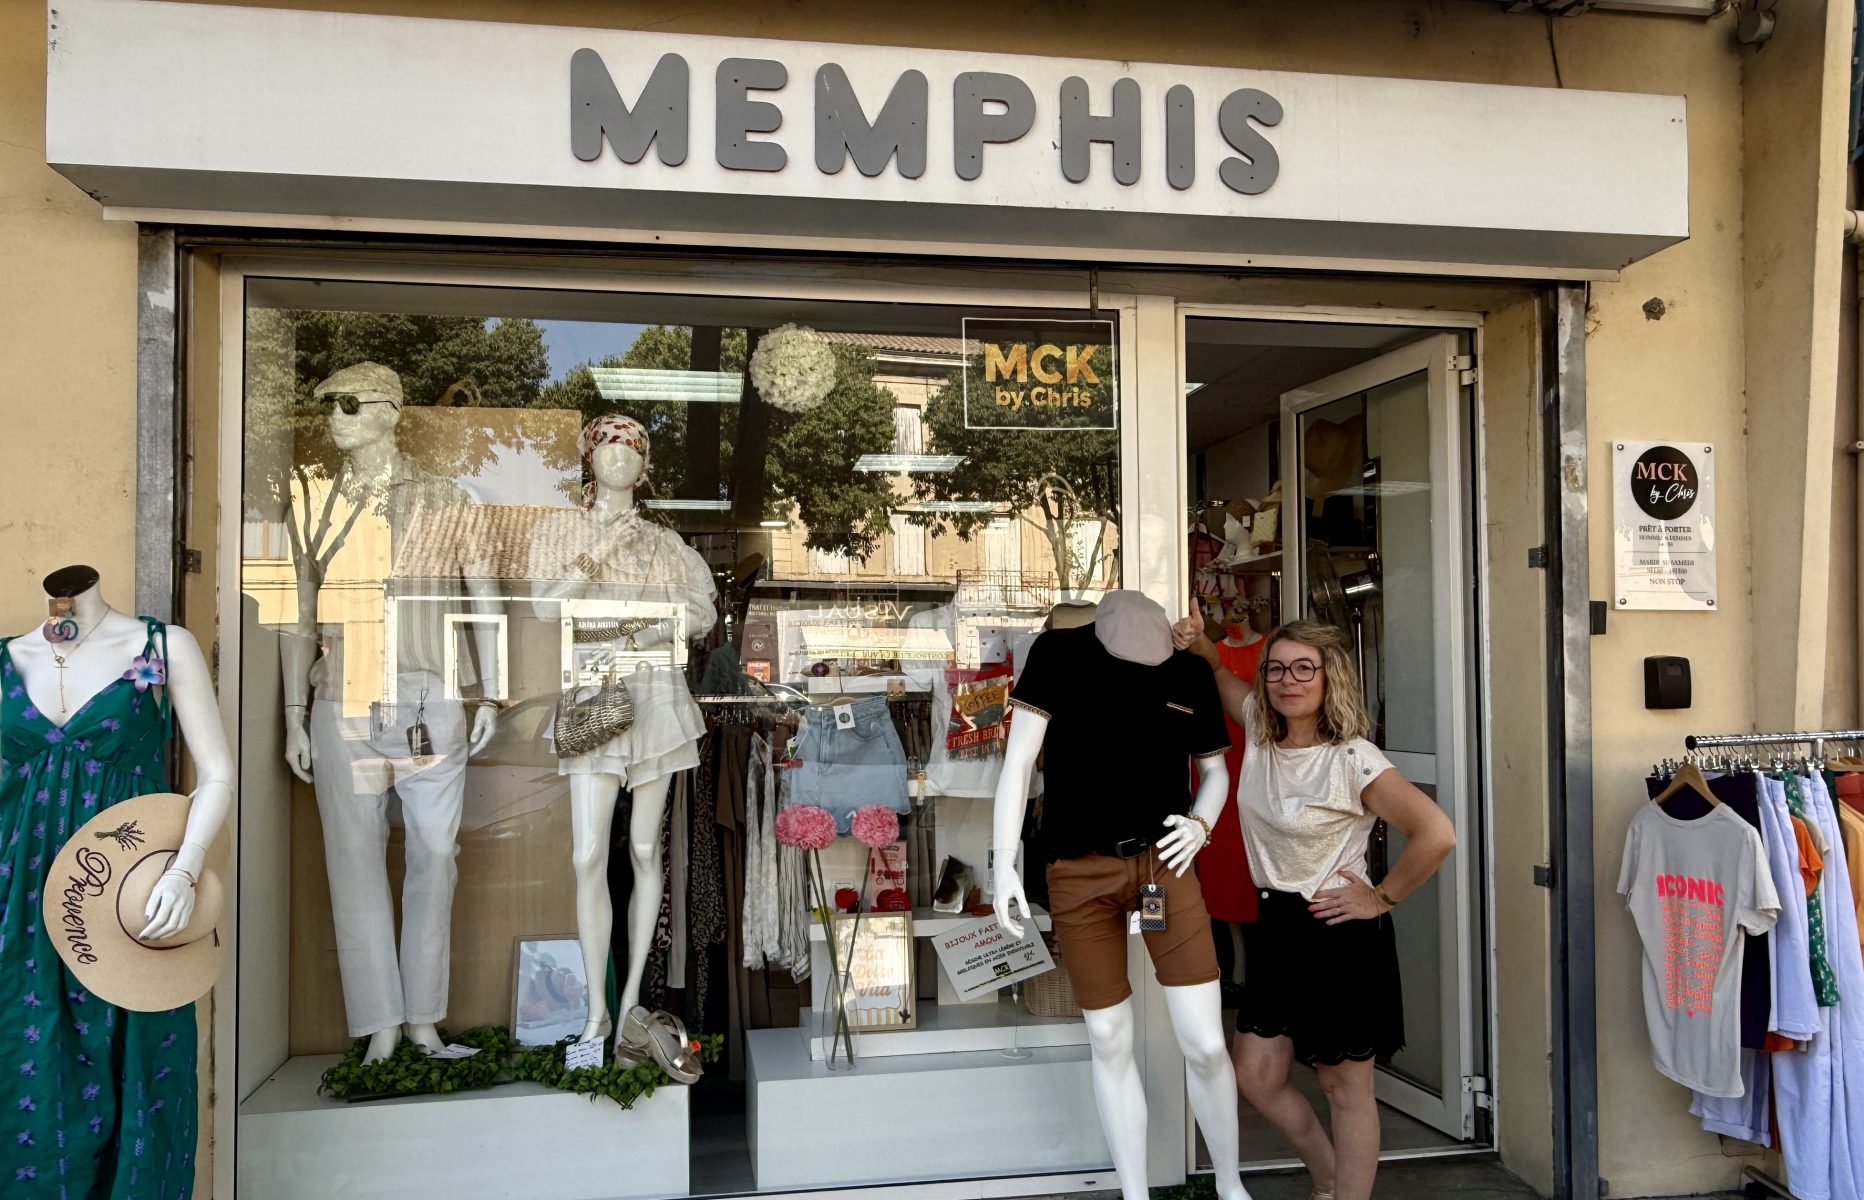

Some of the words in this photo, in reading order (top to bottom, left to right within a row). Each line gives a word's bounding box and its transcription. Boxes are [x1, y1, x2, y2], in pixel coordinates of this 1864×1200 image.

[570, 47, 1284, 195] MEMPHIS
[984, 343, 1100, 384] MCK
[995, 386, 1024, 411] by
[1031, 386, 1092, 408] Chris
[1636, 462, 1688, 481] MCK
[1650, 485, 1664, 504] by
[1665, 483, 1695, 503] Chris
[964, 689, 999, 711] COFFEE
[952, 731, 980, 747] FRESH
[1655, 874, 1726, 908] ICONIC
[62, 847, 112, 965] Provence
[944, 931, 977, 949] BIJOUX
[979, 922, 998, 935] FAIT
[974, 933, 1004, 949] AMOUR
